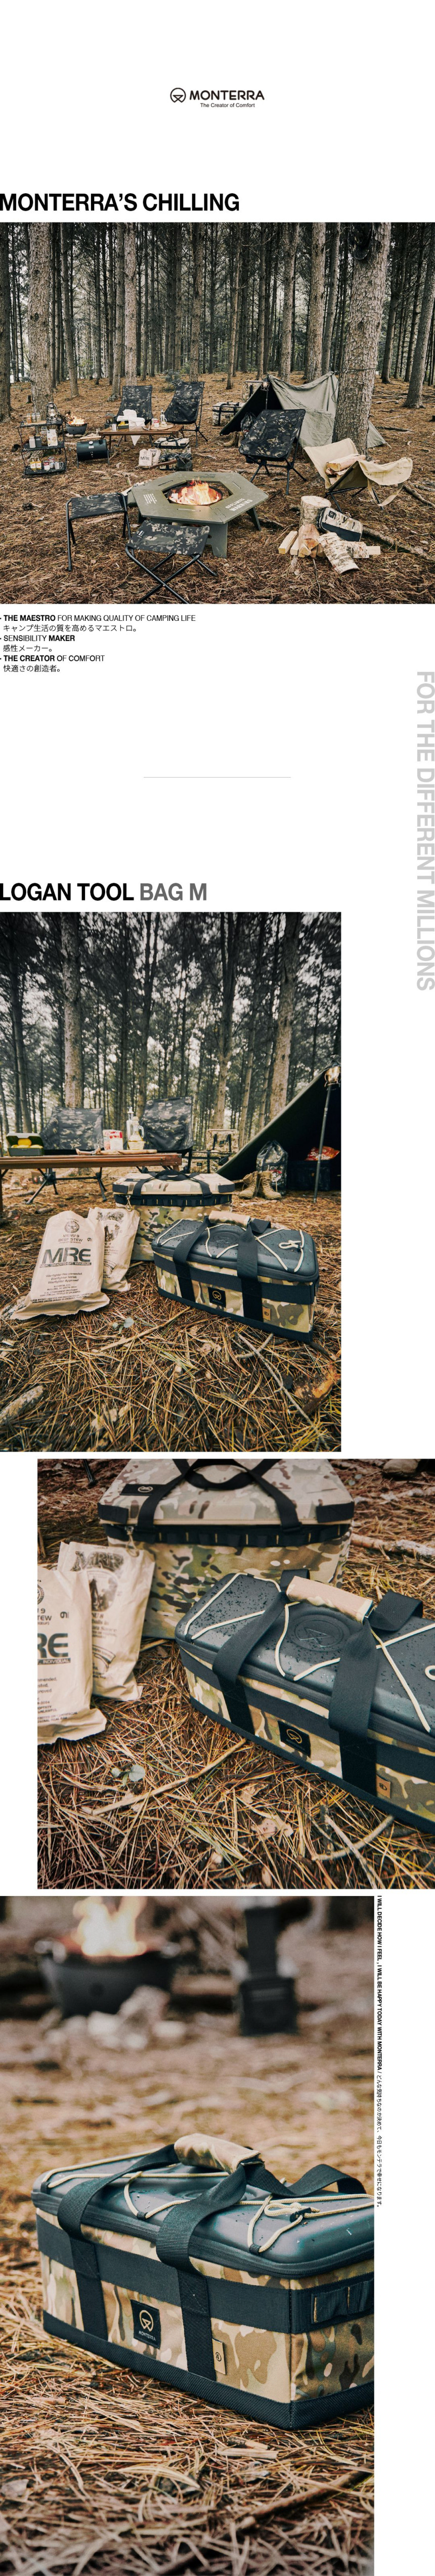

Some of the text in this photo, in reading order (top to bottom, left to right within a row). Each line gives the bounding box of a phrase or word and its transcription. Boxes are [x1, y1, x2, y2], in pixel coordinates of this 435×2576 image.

[229, 499, 253, 511] WARNING
[42, 1247, 91, 1264] MRE
[139, 2330, 156, 2341] MONTERRA
